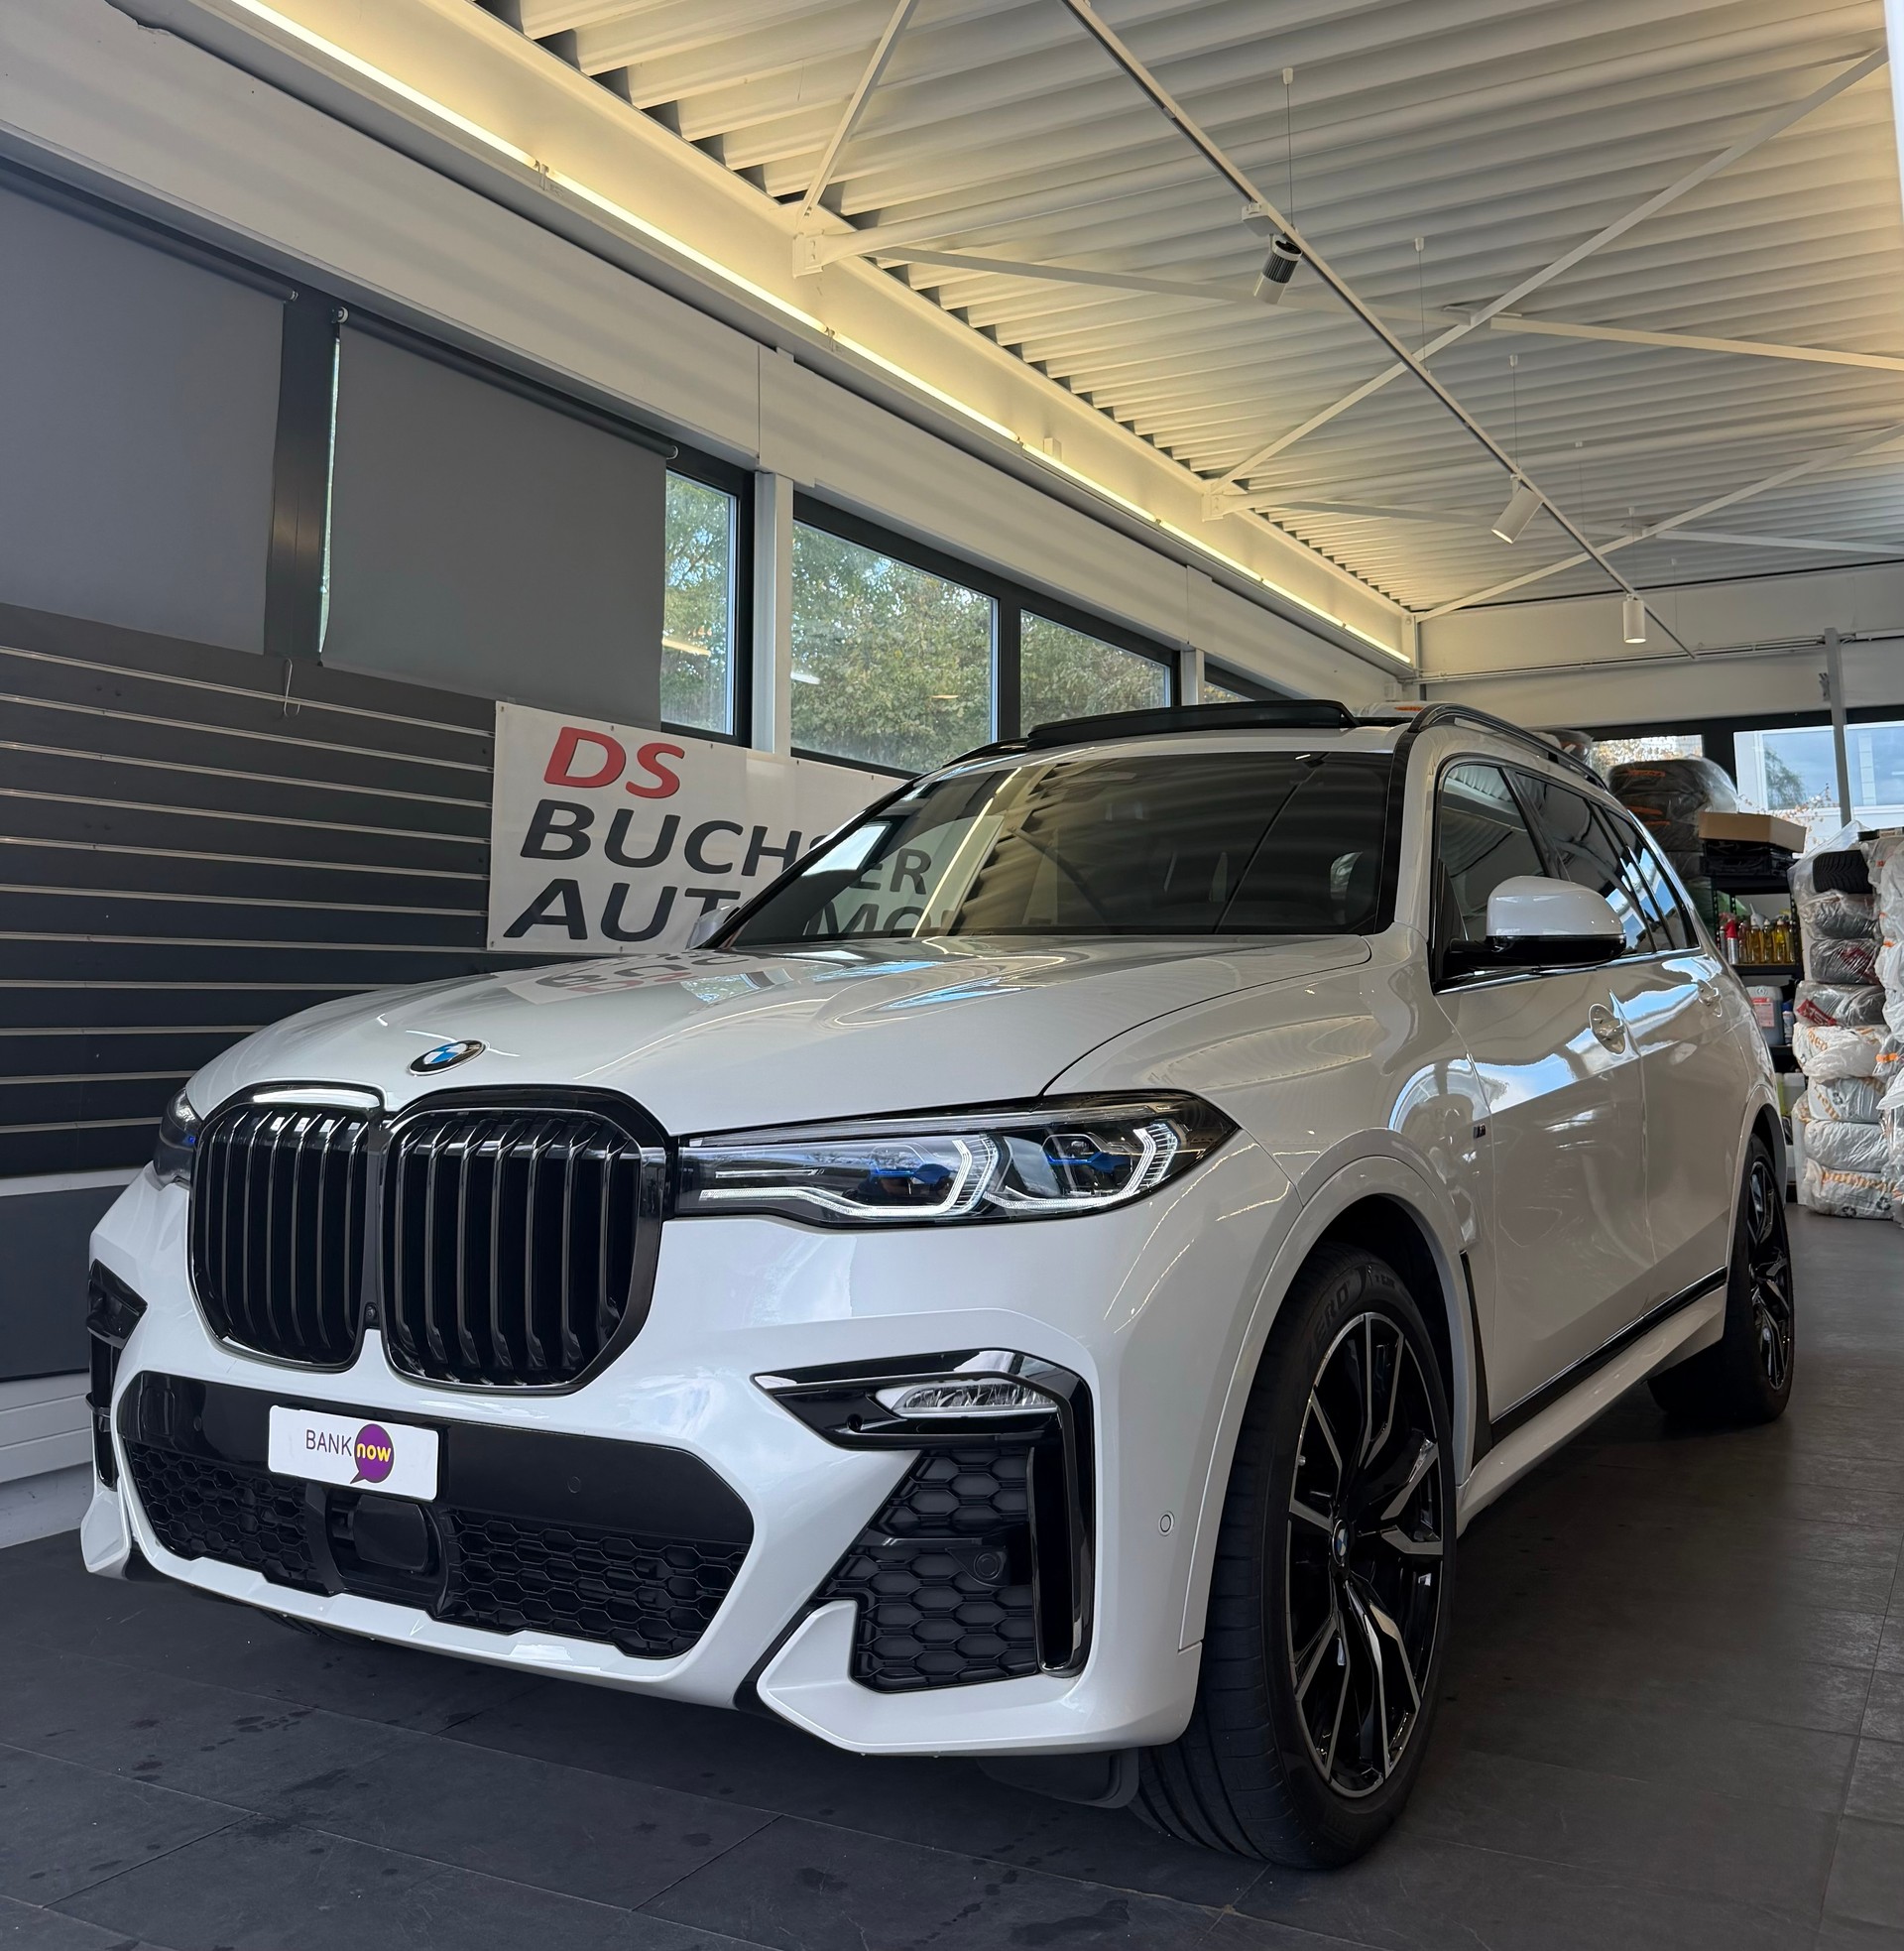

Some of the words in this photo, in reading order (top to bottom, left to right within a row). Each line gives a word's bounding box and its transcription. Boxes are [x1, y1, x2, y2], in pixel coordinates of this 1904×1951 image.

[543, 726, 685, 799] DS
[305, 1429, 352, 1457] BANK
[356, 1443, 392, 1462] now
